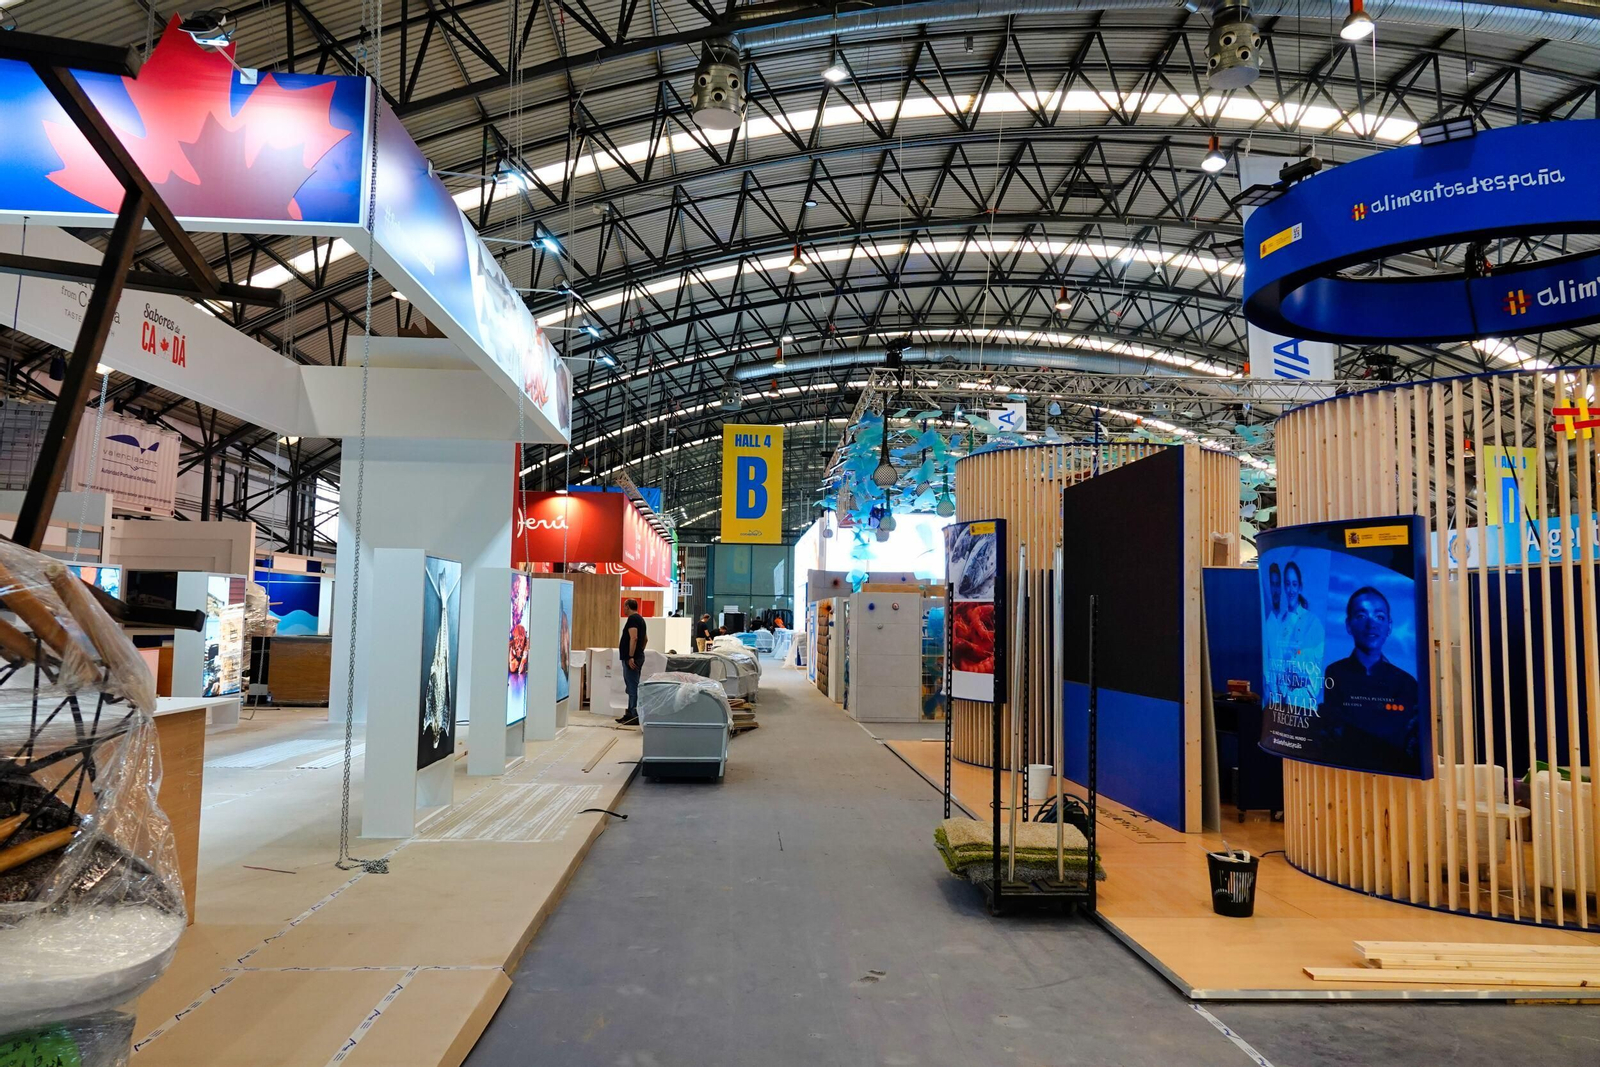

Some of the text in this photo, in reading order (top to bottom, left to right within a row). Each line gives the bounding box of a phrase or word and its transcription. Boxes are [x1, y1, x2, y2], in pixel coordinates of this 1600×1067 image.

[61, 286, 77, 300] from
[64, 308, 82, 323] TASTE
[143, 303, 175, 331] Sabores
[735, 434, 771, 448] HALL 4
[103, 449, 158, 467] valenciaport
[1494, 455, 1518, 469] ALL
[736, 456, 768, 519] B
[1526, 519, 1599, 558] Agt
[1269, 692, 1321, 718] DEL MAR
[1277, 712, 1310, 729] RECETAS
